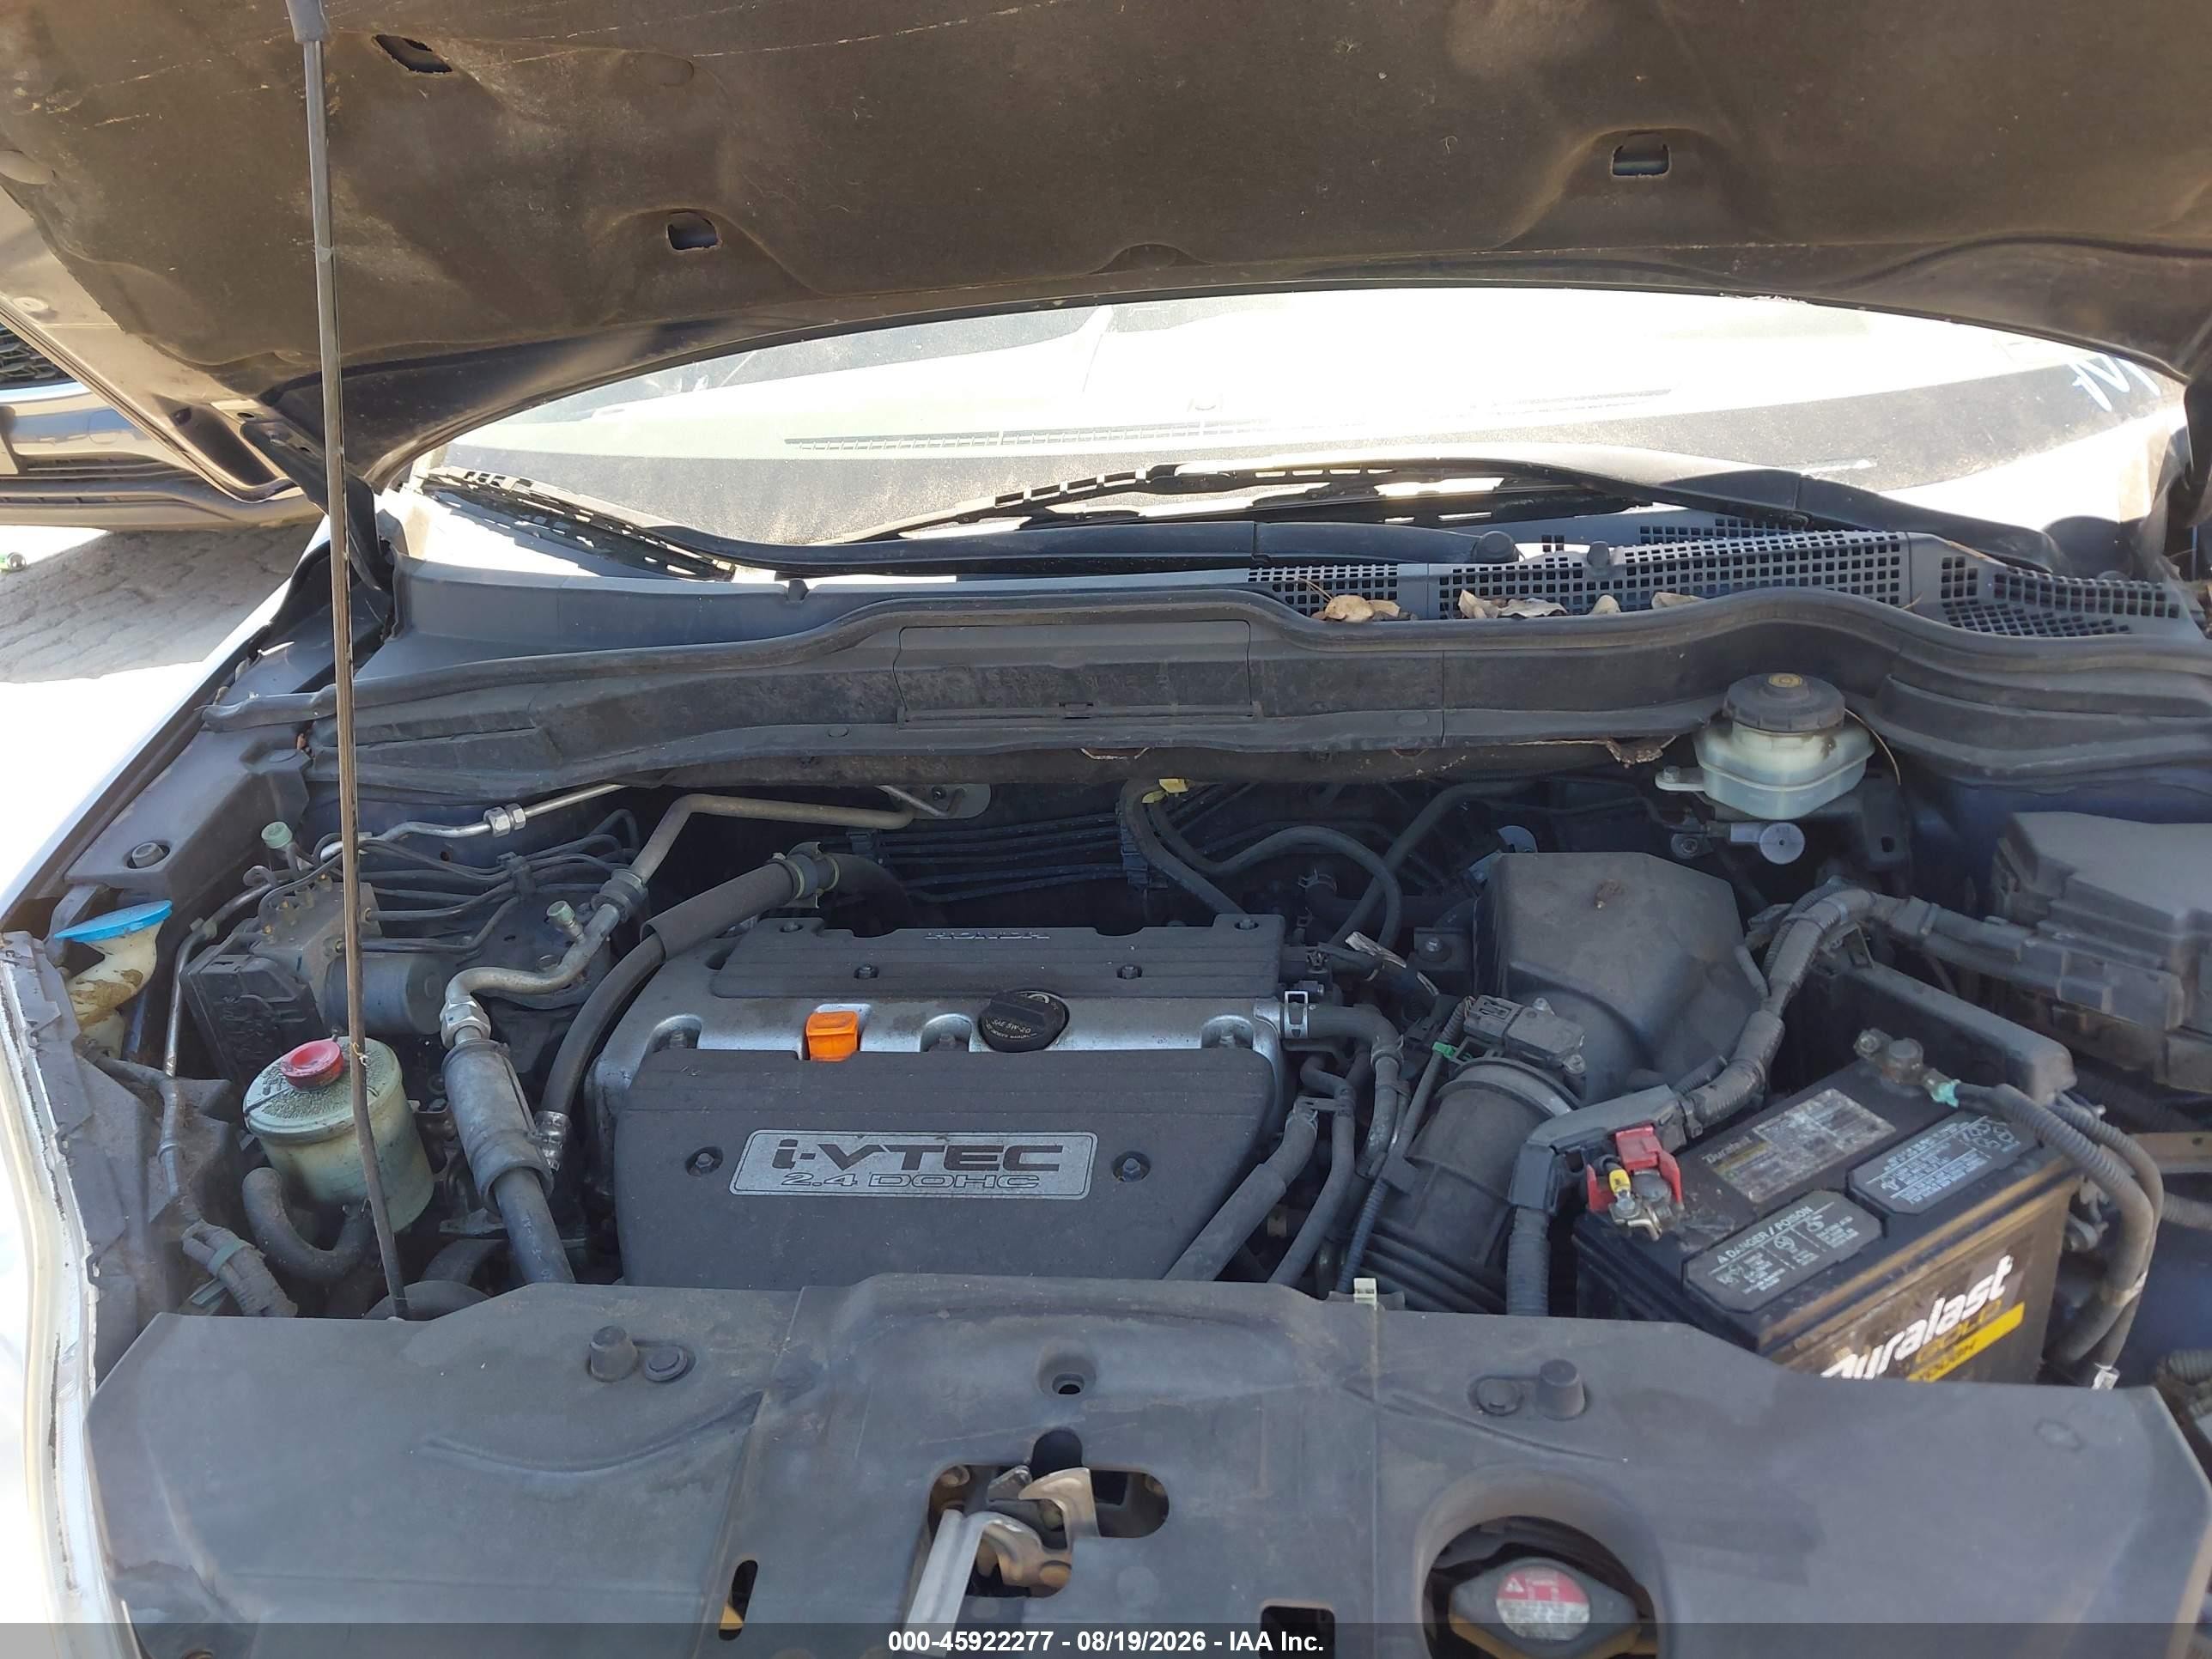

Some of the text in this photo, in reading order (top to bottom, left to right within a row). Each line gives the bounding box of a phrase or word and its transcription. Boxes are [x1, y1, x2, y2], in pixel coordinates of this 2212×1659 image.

[772, 1138, 1064, 1172] i-VTEC
[781, 1171, 1041, 1189] 2.4 DOHC
[1725, 1230, 1770, 1259] DANGER
[1774, 1206, 1814, 1232] POISON
